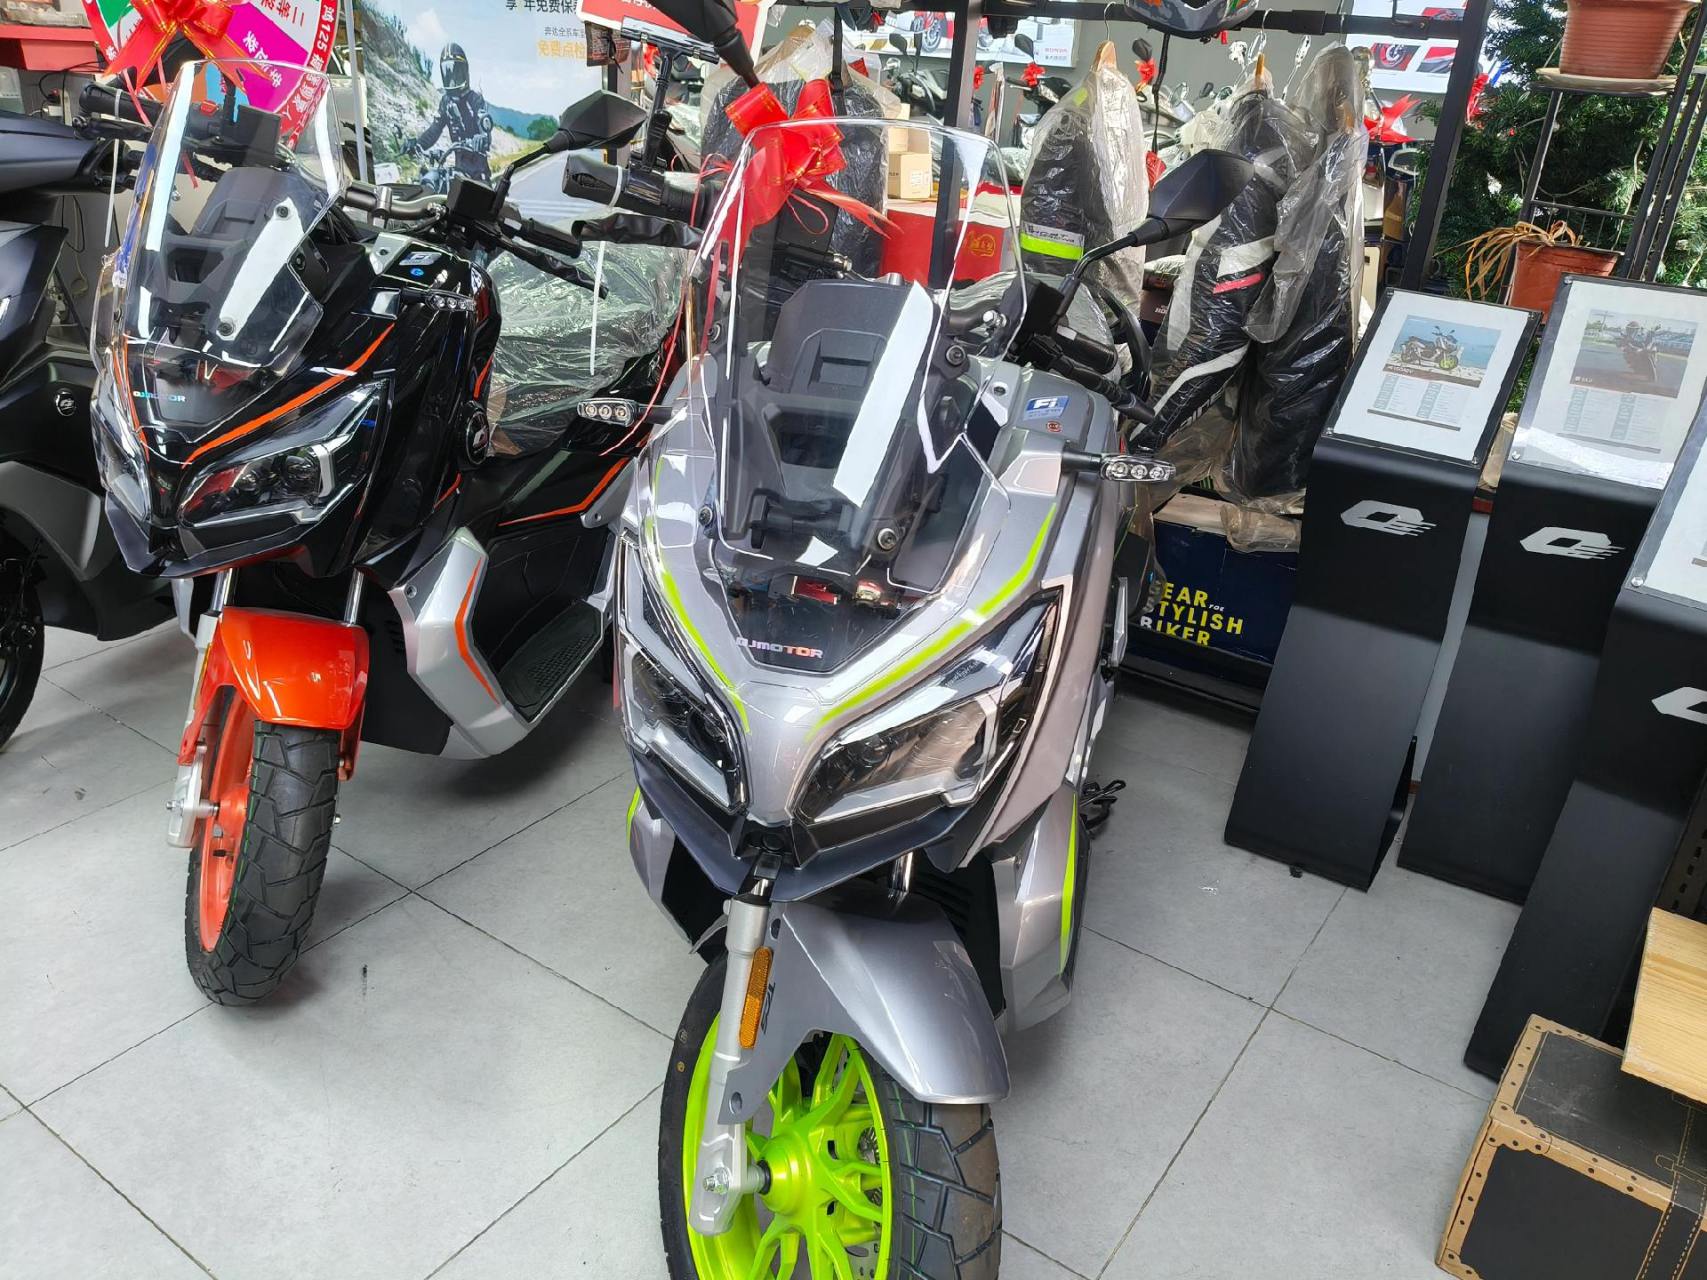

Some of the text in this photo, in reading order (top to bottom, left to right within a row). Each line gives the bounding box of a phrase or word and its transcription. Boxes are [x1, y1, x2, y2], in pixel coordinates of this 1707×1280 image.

[1162, 582, 1208, 608] EAR
[1159, 601, 1243, 635] TYLISH
[735, 637, 824, 659] QJMOTOR
